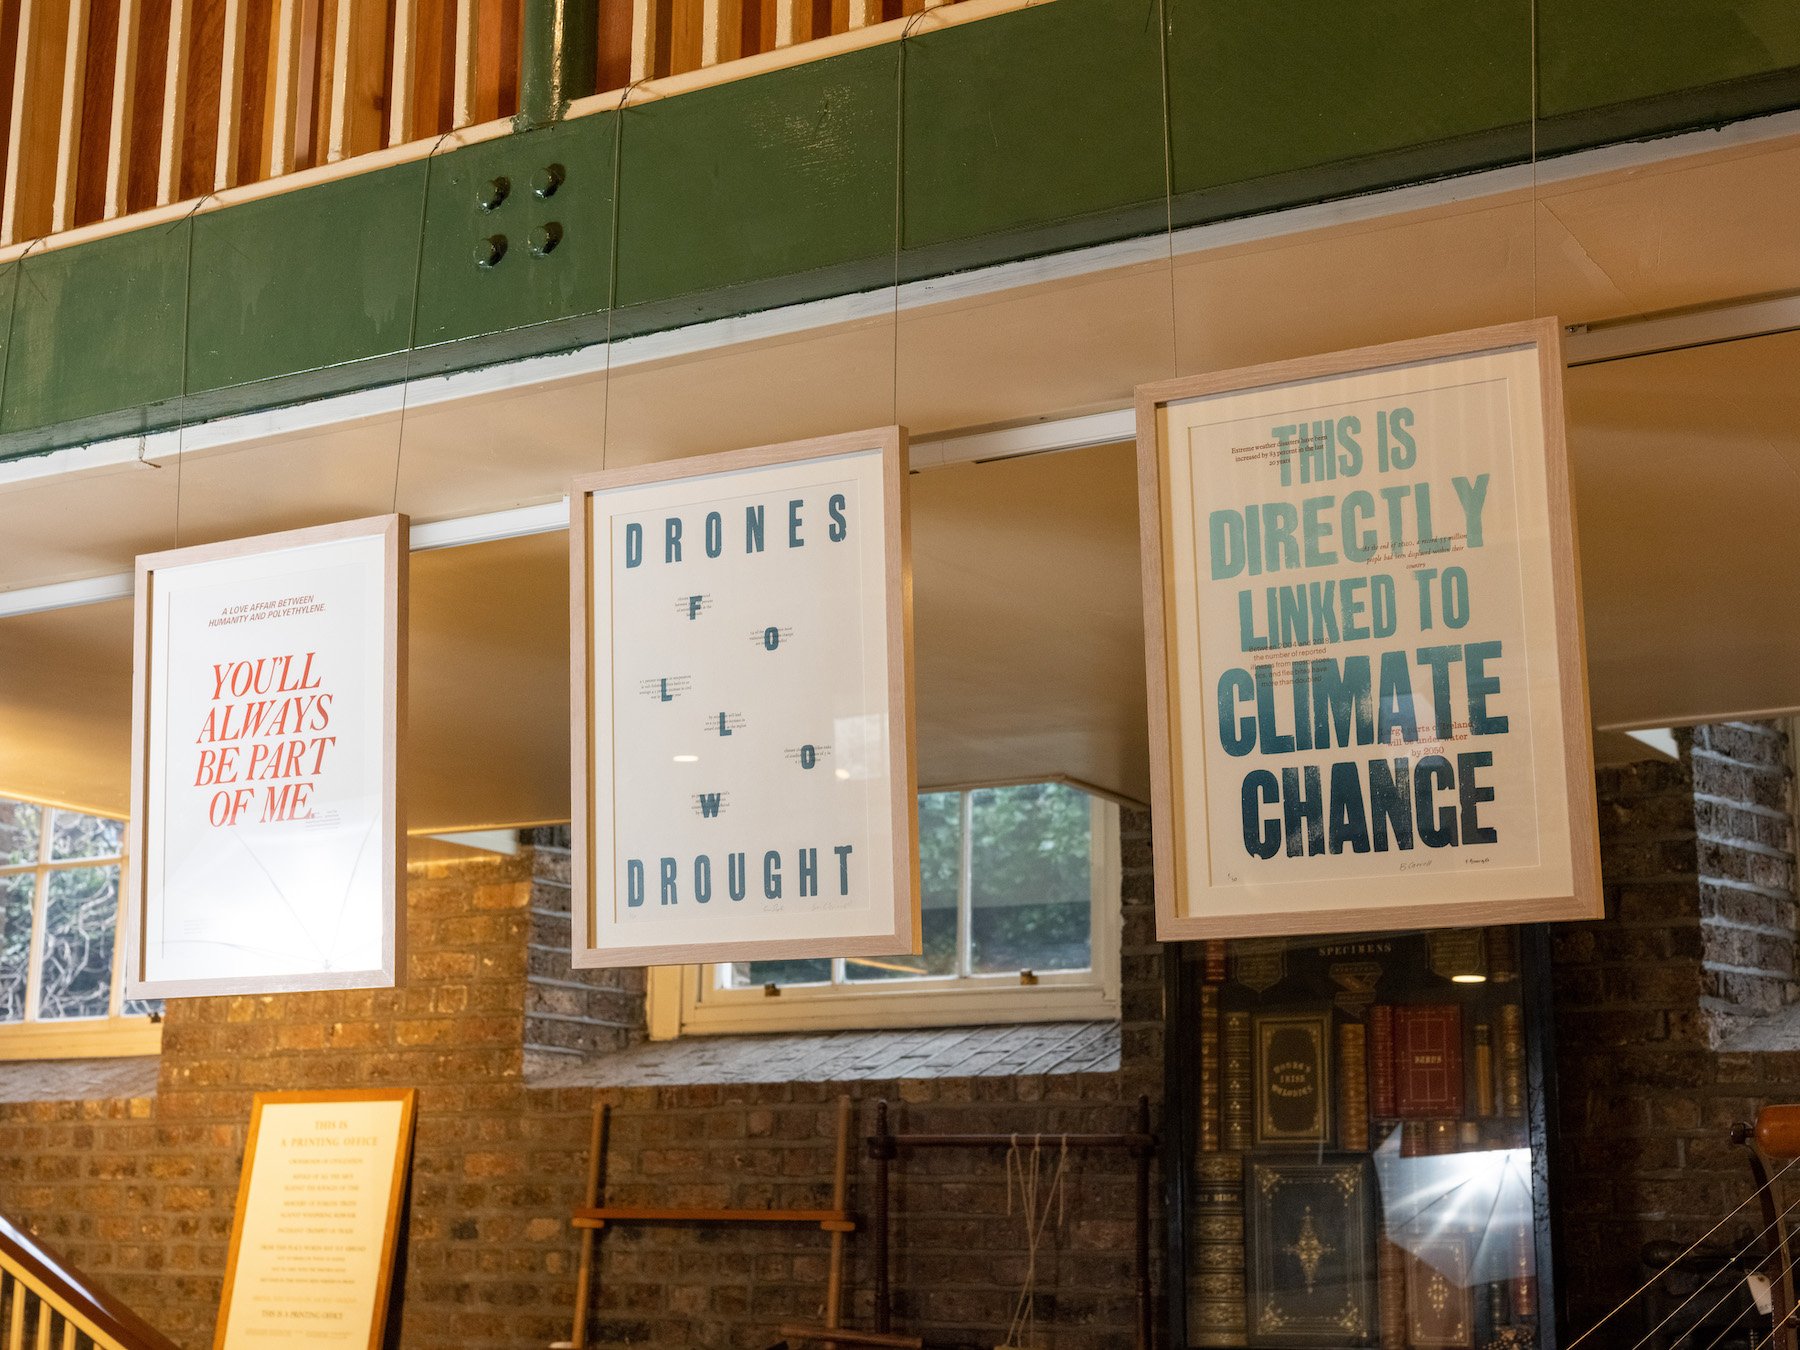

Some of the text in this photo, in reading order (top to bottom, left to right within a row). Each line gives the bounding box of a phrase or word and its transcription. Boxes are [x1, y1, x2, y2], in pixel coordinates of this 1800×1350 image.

[1231, 446, 1254, 454] Extreme
[1255, 442, 1276, 450] weather
[1236, 454, 1260, 462] increased
[1261, 452, 1268, 460] by
[1277, 448, 1298, 456] percent
[1271, 407, 1416, 487] THIS IS
[1276, 458, 1290, 466] years
[626, 493, 847, 568] DRONES
[1209, 473, 1490, 581] DIRECTLY
[208, 614, 248, 627] HUMANITY
[250, 612, 266, 622] AND
[230, 604, 248, 615] LOVE
[250, 600, 276, 612] AFFAIR
[278, 595, 314, 608] BETWEEN
[689, 595, 702, 620] F
[1238, 566, 1470, 653] LINKED TO
[1265, 652, 1290, 660] number
[1291, 650, 1298, 658] of
[1299, 647, 1326, 658] reported
[1276, 660, 1291, 668] from
[211, 652, 321, 700] YOU'LL
[1280, 678, 1294, 686] than
[1217, 640, 1509, 757] CLIMATE
[196, 694, 333, 744] ALWAYS
[193, 736, 336, 786] BE PART
[1411, 746, 1444, 758] by 2050
[209, 788, 255, 827] OF
[699, 793, 720, 818] W
[1242, 751, 1497, 860] CHANGE
[628, 846, 853, 908] DROUGHT
